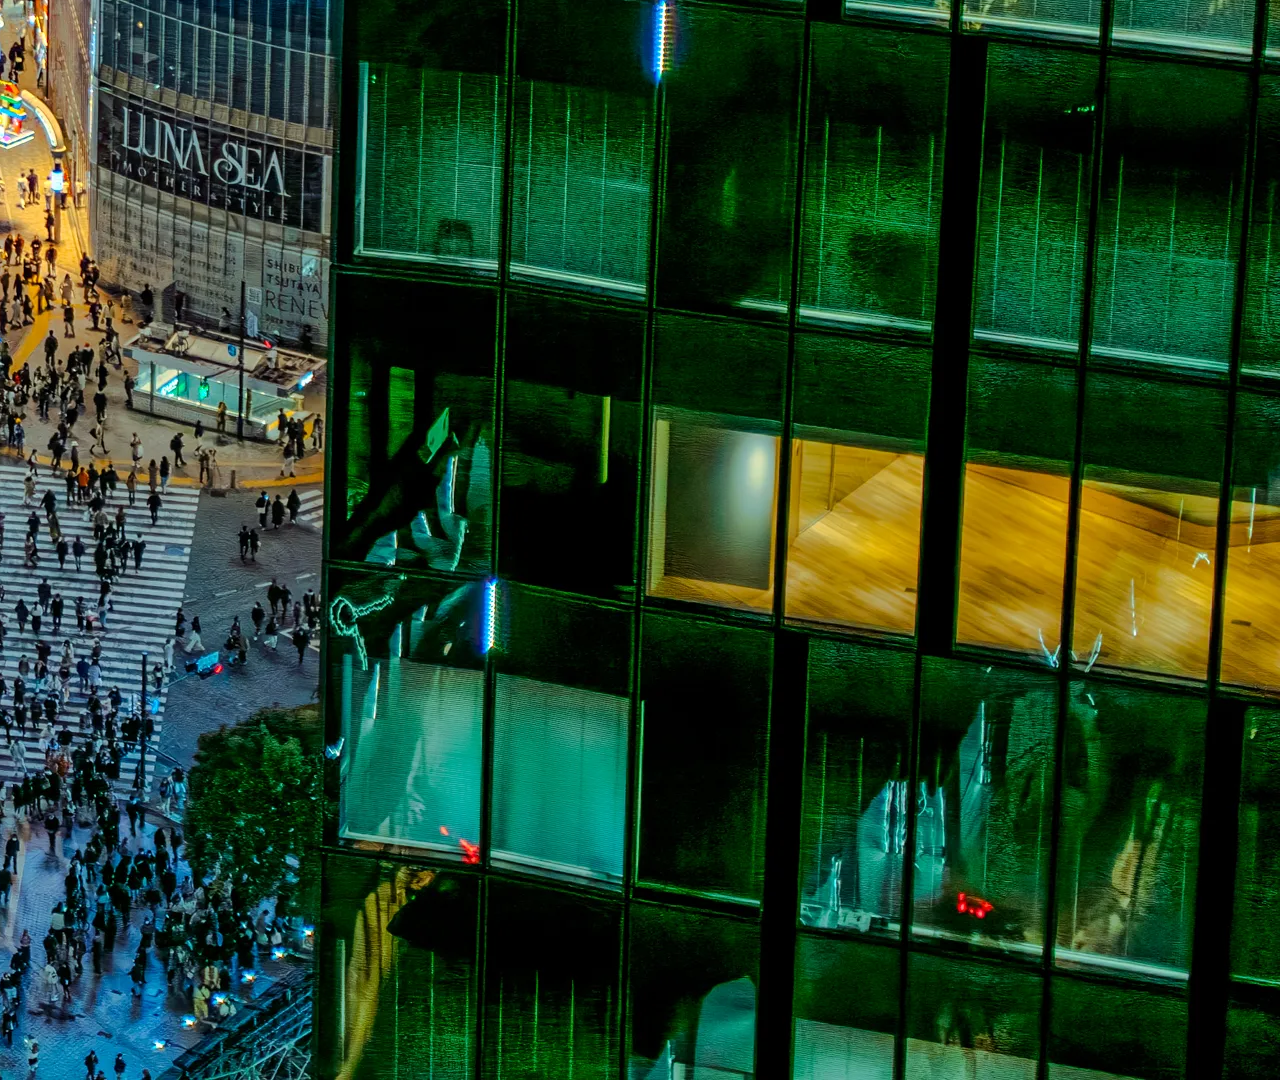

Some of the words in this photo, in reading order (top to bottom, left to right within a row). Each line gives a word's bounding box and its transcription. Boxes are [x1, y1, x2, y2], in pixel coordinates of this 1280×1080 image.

[121, 106, 210, 177] LUNA
[213, 140, 292, 198] SEA
[123, 161, 202, 198] MOTHER
